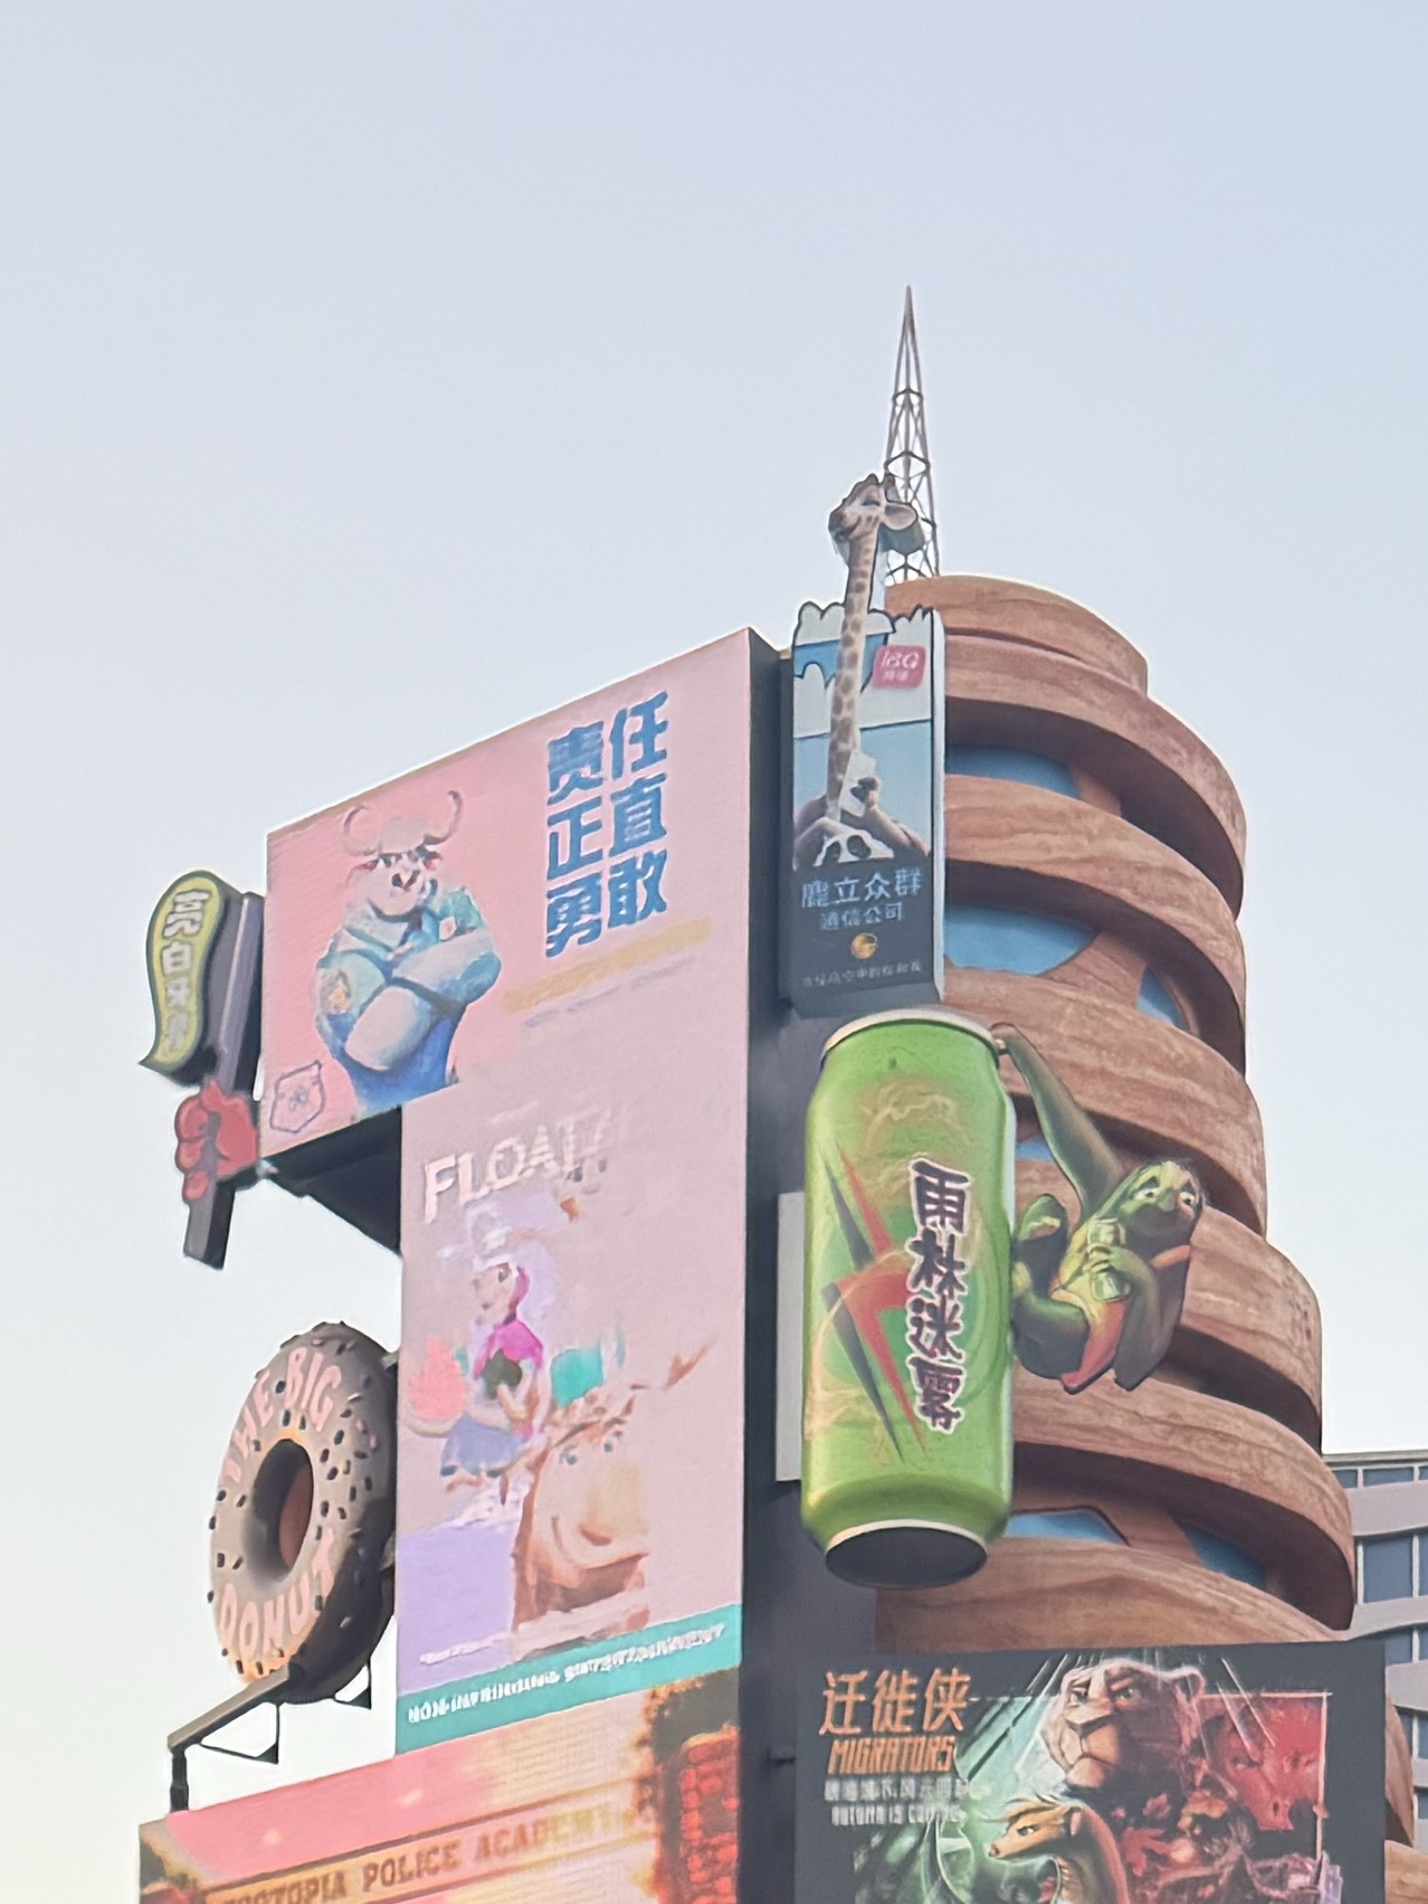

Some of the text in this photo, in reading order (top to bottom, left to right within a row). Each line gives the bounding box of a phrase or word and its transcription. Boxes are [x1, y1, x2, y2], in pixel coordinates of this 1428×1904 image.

[547, 691, 668, 805] 责任
[547, 773, 667, 880] 正直
[546, 849, 667, 957] 勇敢
[283, 1347, 341, 1431] BIG
[220, 1529, 336, 1656] DONUT
[819, 1668, 971, 1735] 迁徙侠
[828, 1736, 956, 1775] MIGRATORS
[362, 1842, 461, 1893] POLICE
